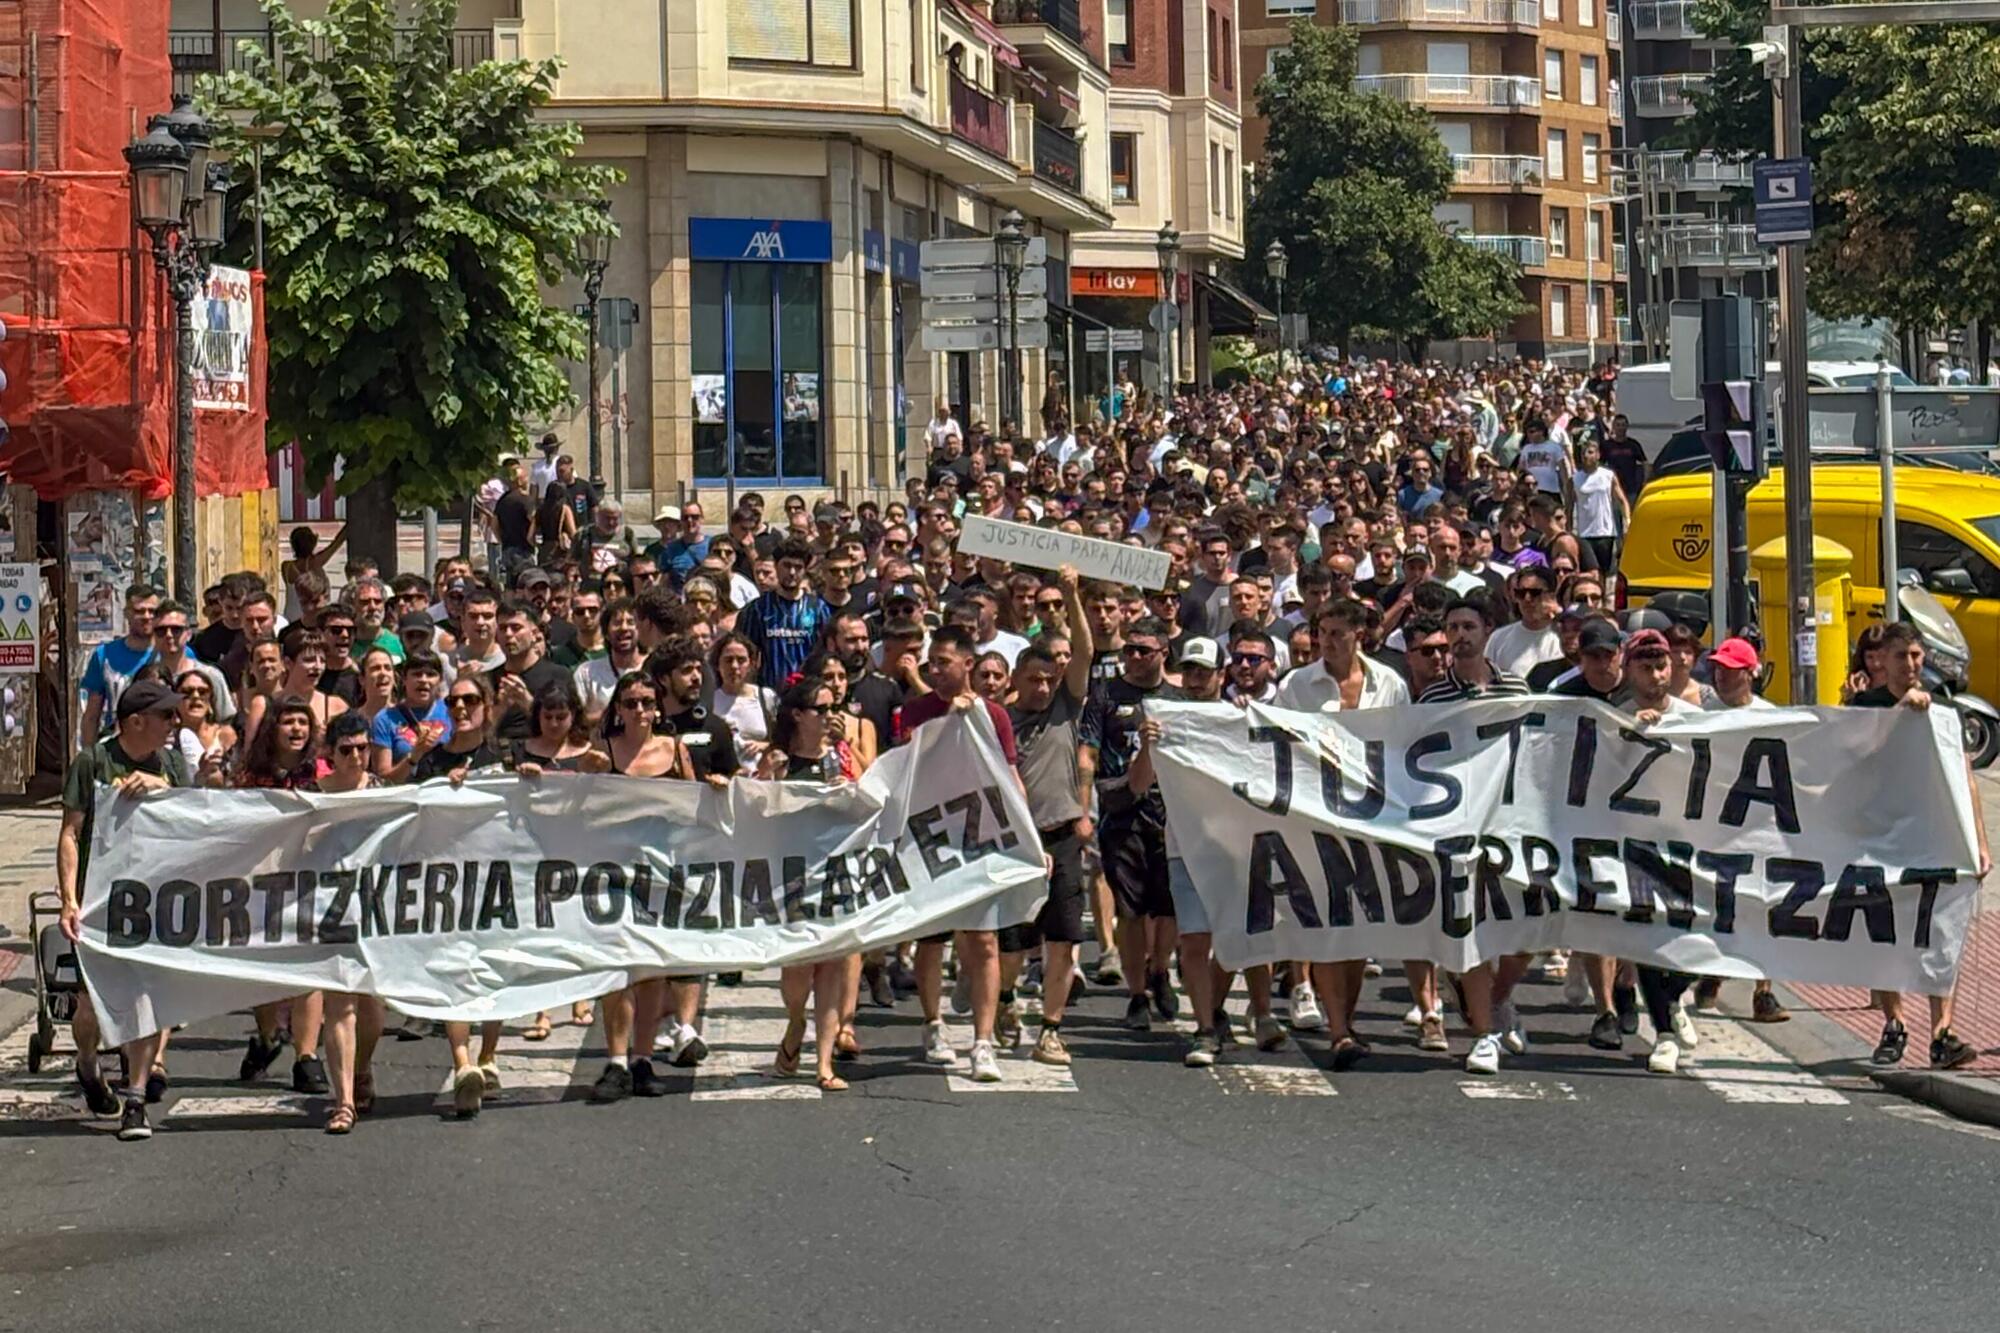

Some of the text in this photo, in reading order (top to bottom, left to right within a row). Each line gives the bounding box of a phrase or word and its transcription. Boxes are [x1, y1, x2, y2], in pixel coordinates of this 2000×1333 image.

[743, 231, 784, 258] AXA
[2, 567, 24, 578] TODAS
[982, 523, 1060, 551] JUSTICIA
[1070, 539, 1109, 562] PARA
[1232, 712, 1801, 834] JUSTIZIA
[107, 860, 519, 948] BORTIZKERIA
[907, 785, 1020, 882] EZ!
[1246, 830, 1957, 948] ANDERRENTZAT
